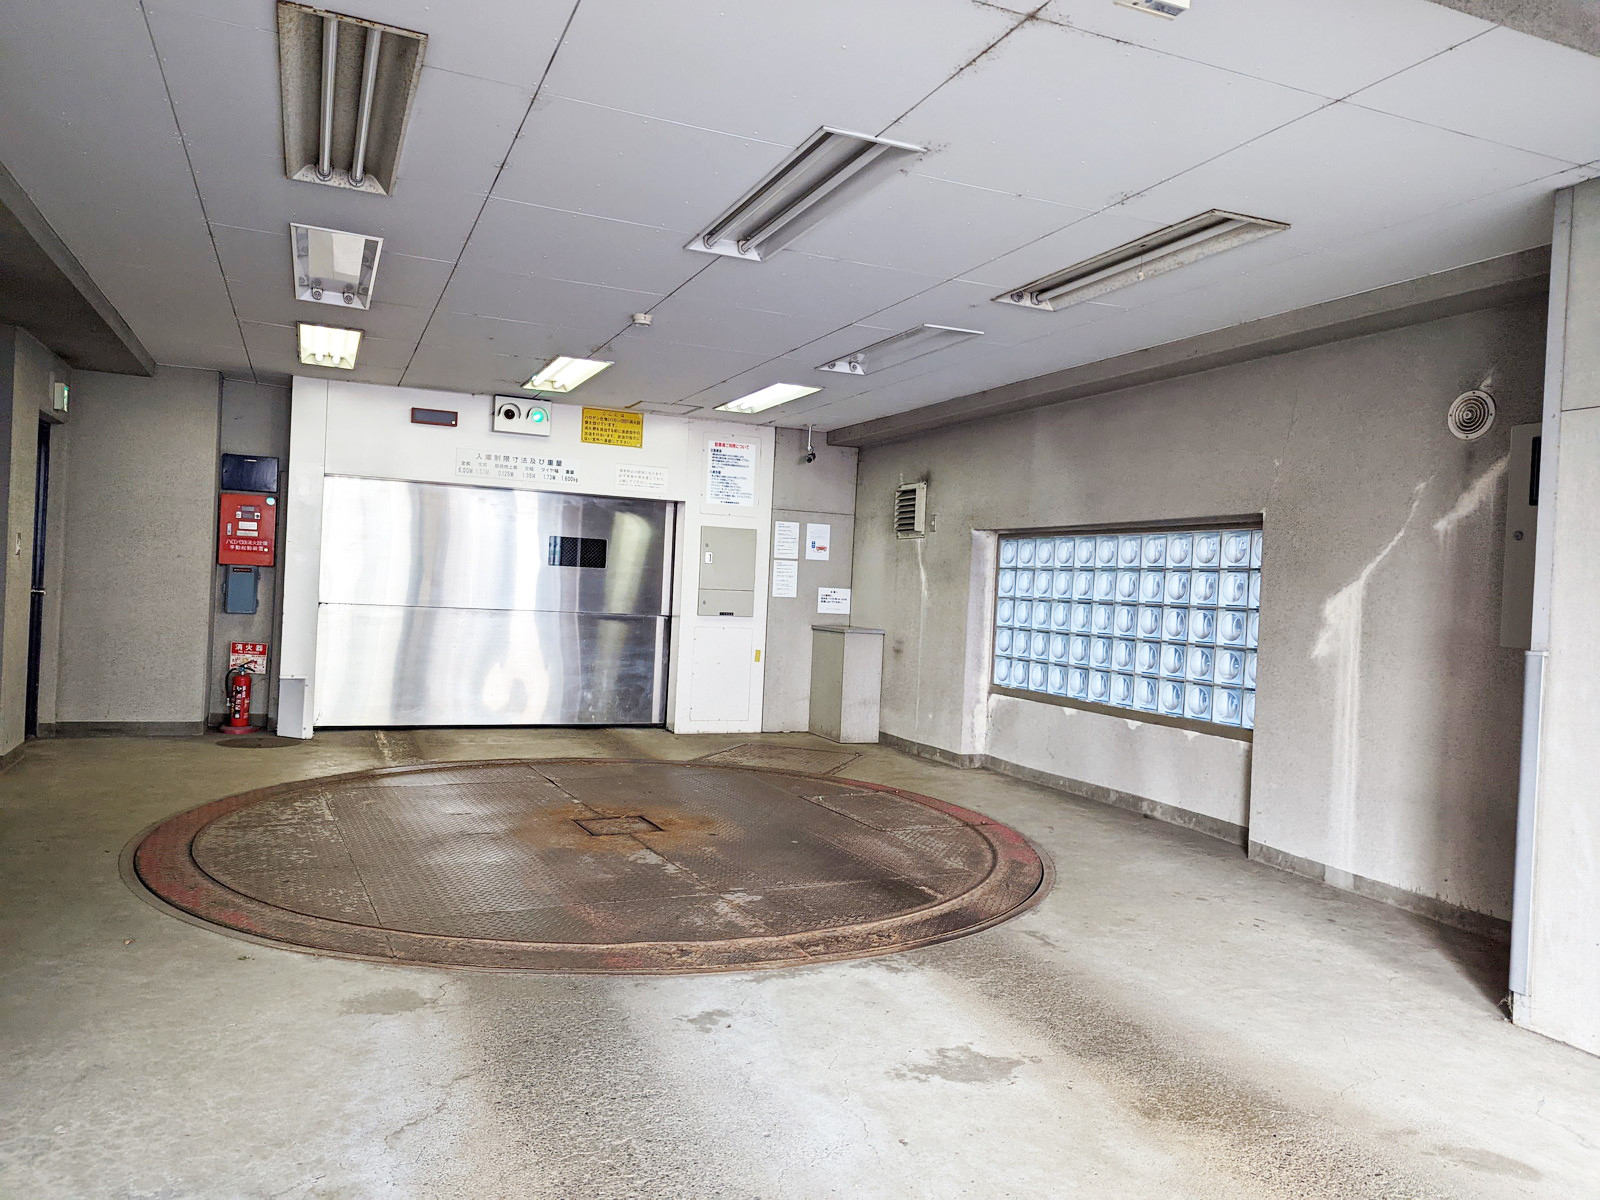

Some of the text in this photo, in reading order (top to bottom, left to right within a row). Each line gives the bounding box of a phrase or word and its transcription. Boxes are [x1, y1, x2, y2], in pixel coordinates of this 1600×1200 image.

[475, 453, 562, 467] 入庫制限寸法及び重量
[235, 643, 263, 652] 消火器
